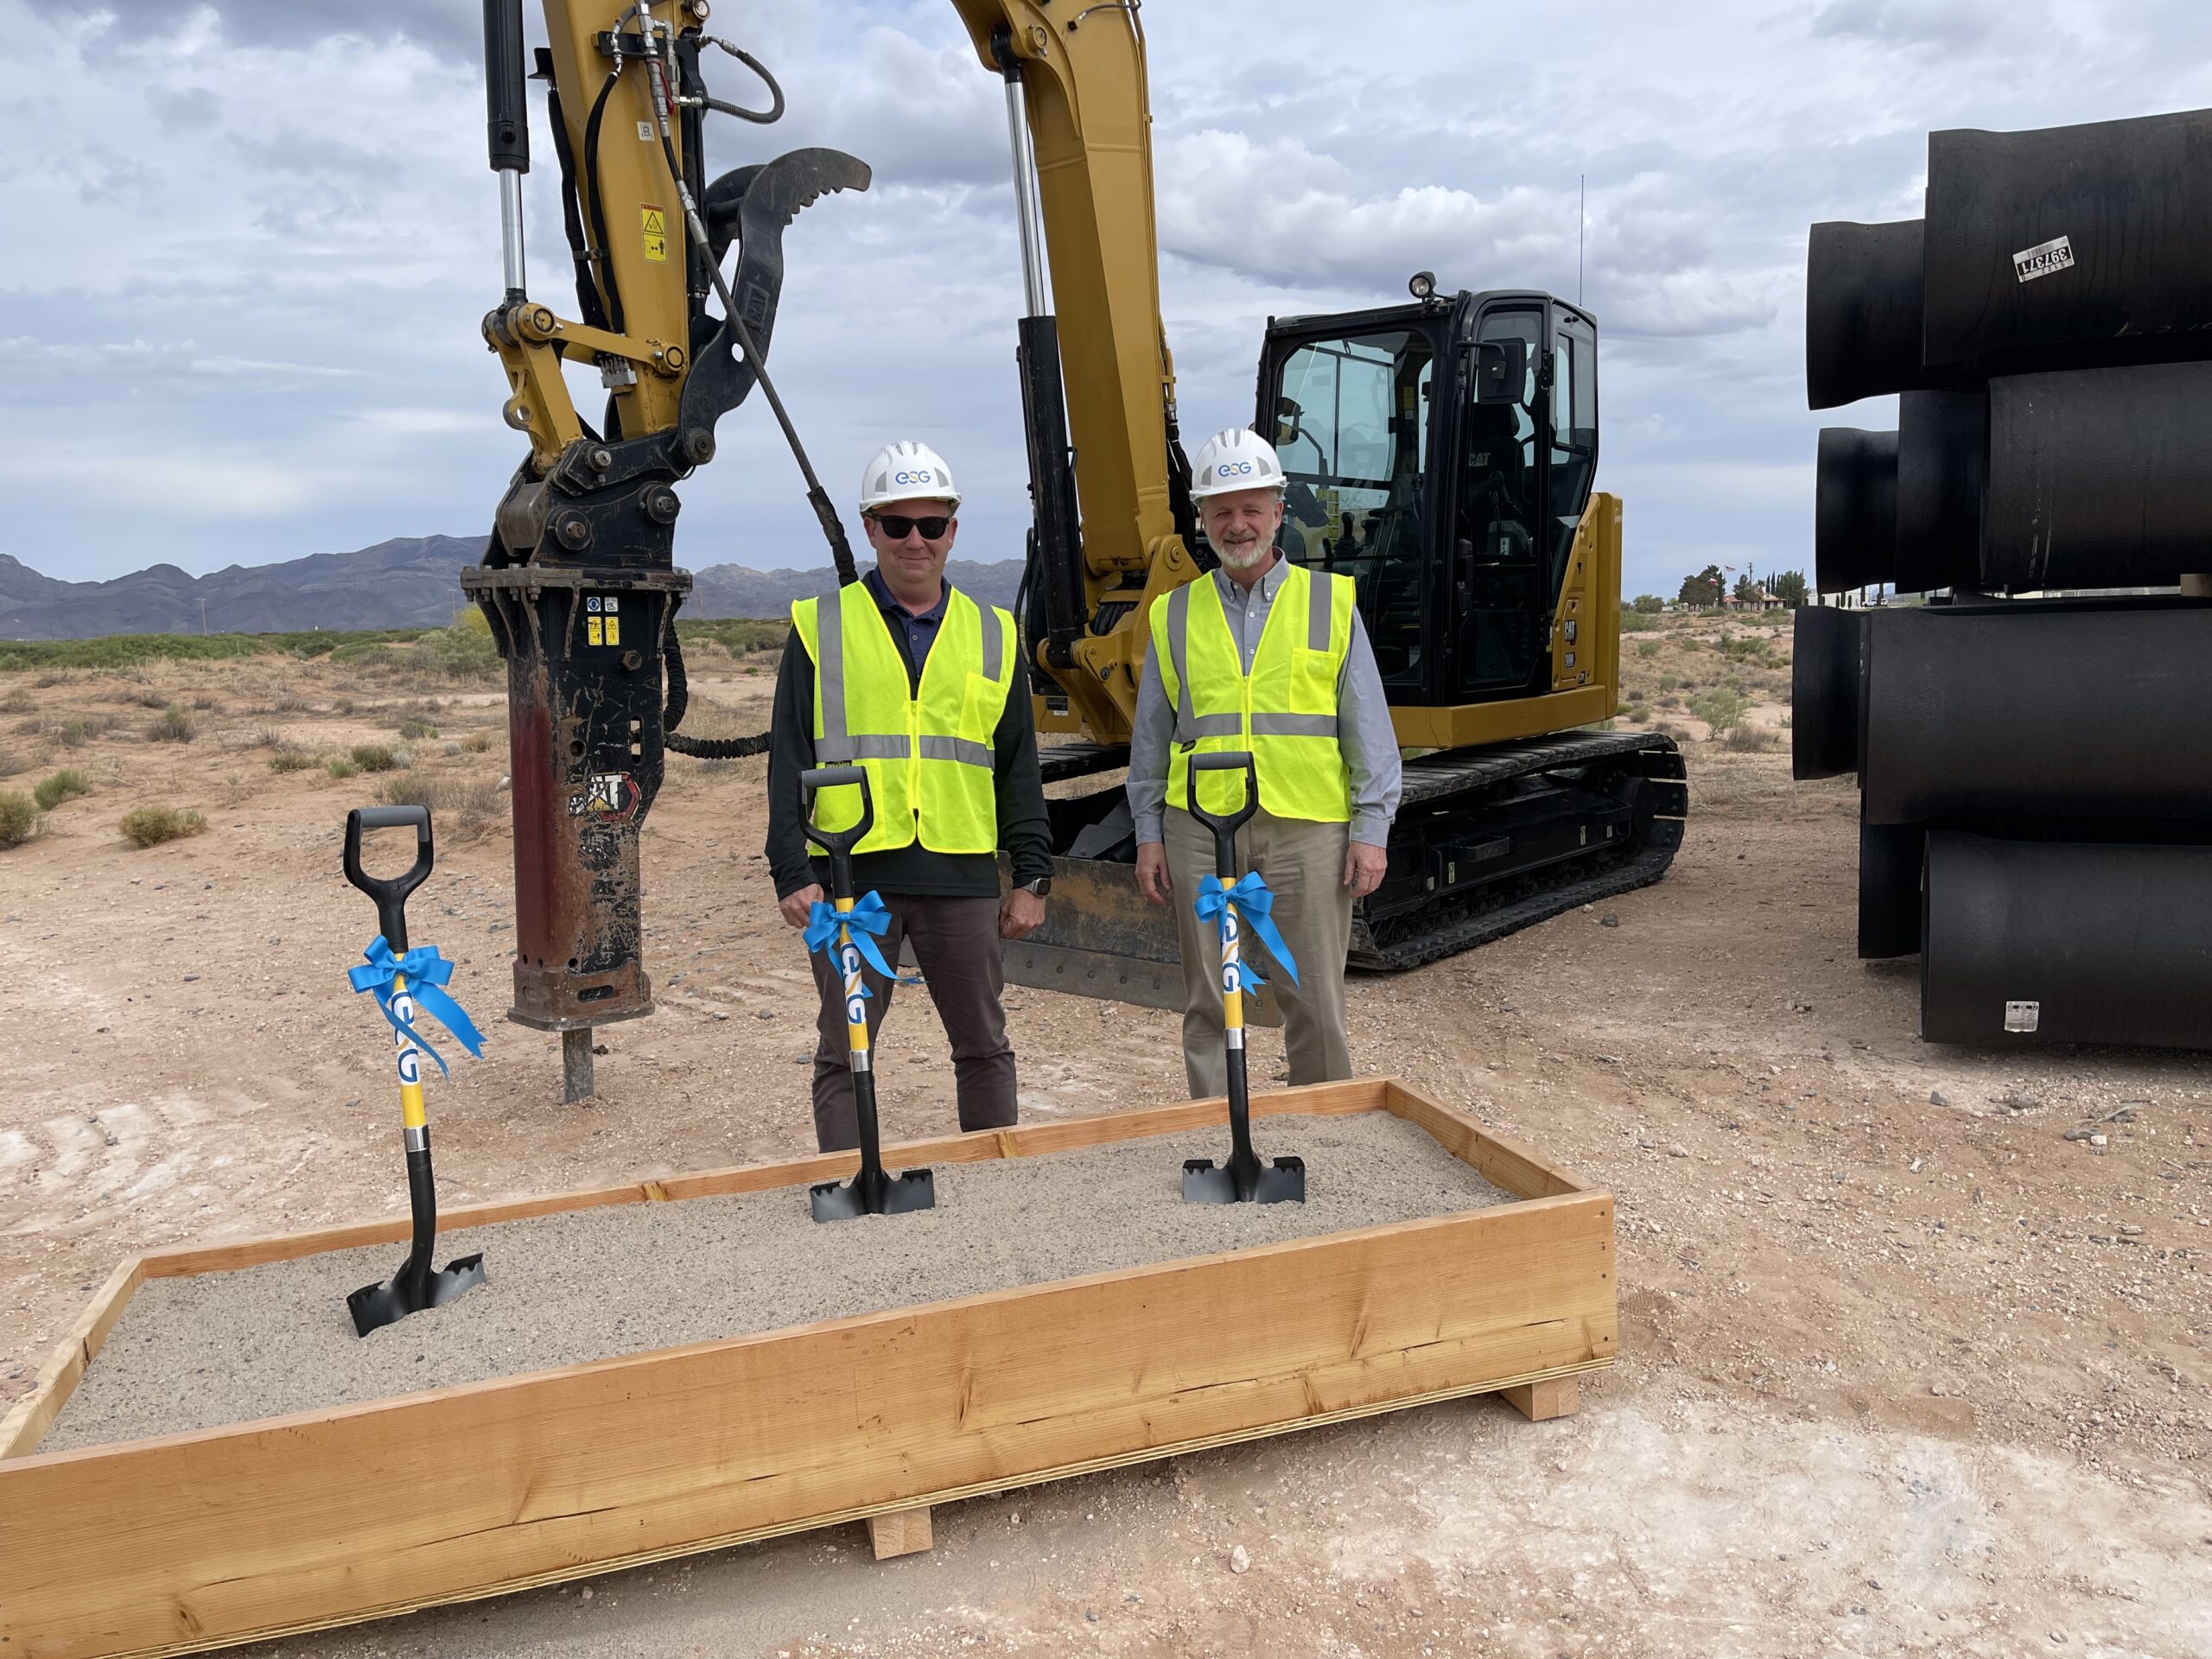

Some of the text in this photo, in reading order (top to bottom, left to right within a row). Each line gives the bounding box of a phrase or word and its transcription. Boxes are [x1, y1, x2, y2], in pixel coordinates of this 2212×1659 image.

[2021, 248, 2068, 274] 397371
[1468, 452, 1491, 467] CAT
[1564, 620, 1576, 640] CAT
